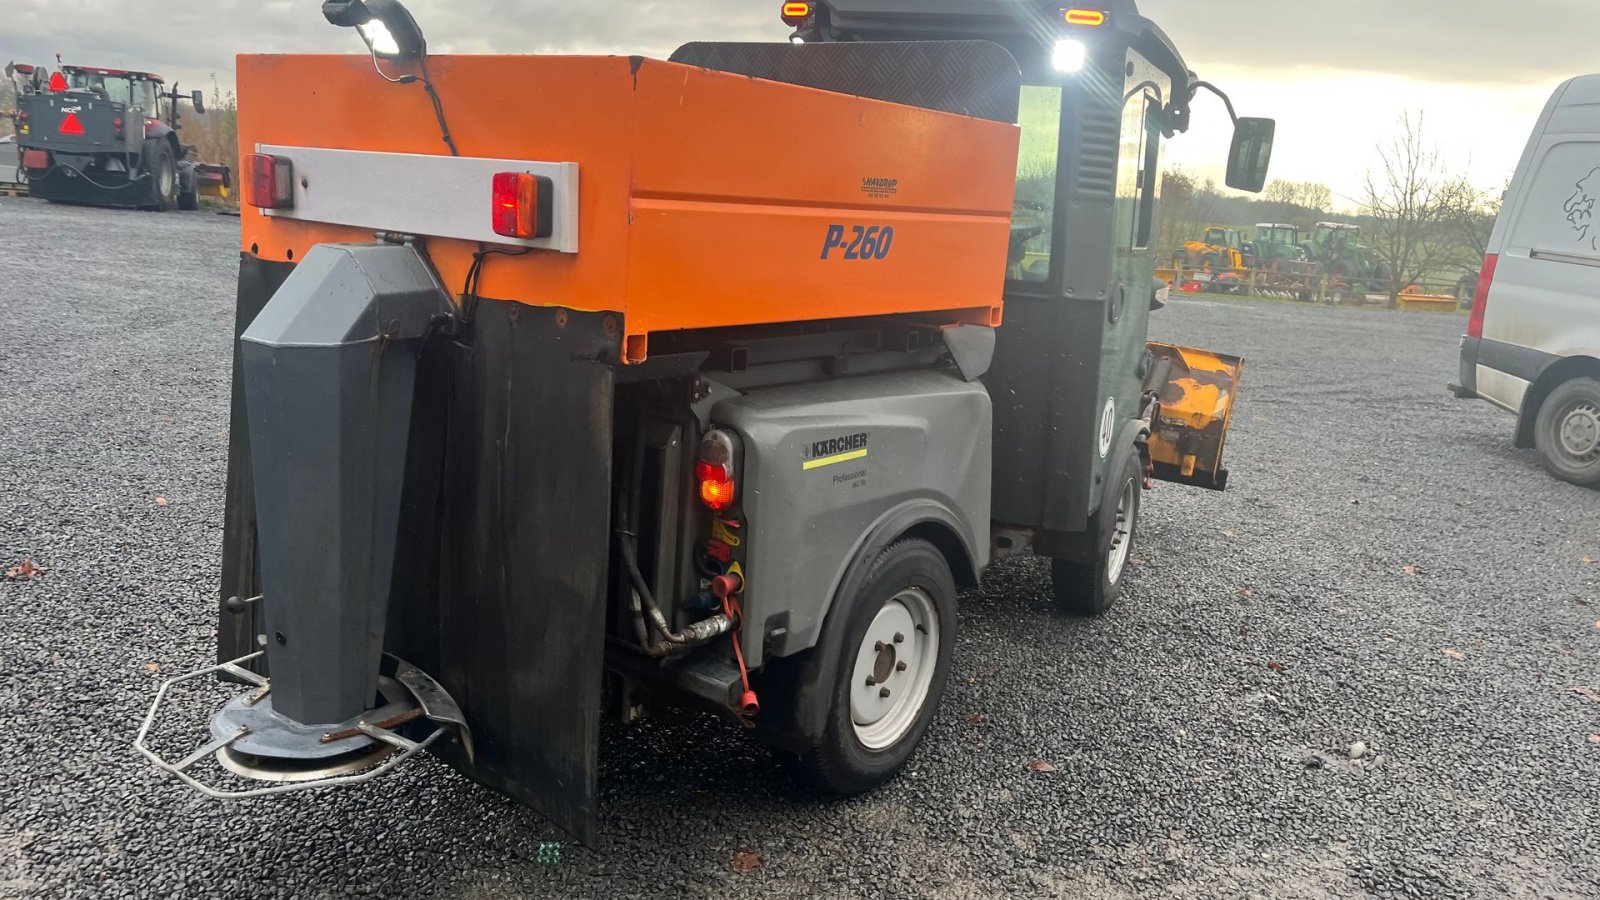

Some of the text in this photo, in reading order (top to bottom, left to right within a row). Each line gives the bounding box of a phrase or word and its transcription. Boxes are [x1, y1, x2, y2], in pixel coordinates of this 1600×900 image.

[820, 224, 894, 260] P-260
[1102, 407, 1113, 447] 40
[812, 432, 868, 457] KÄRCHER
[832, 468, 867, 485] Professional
